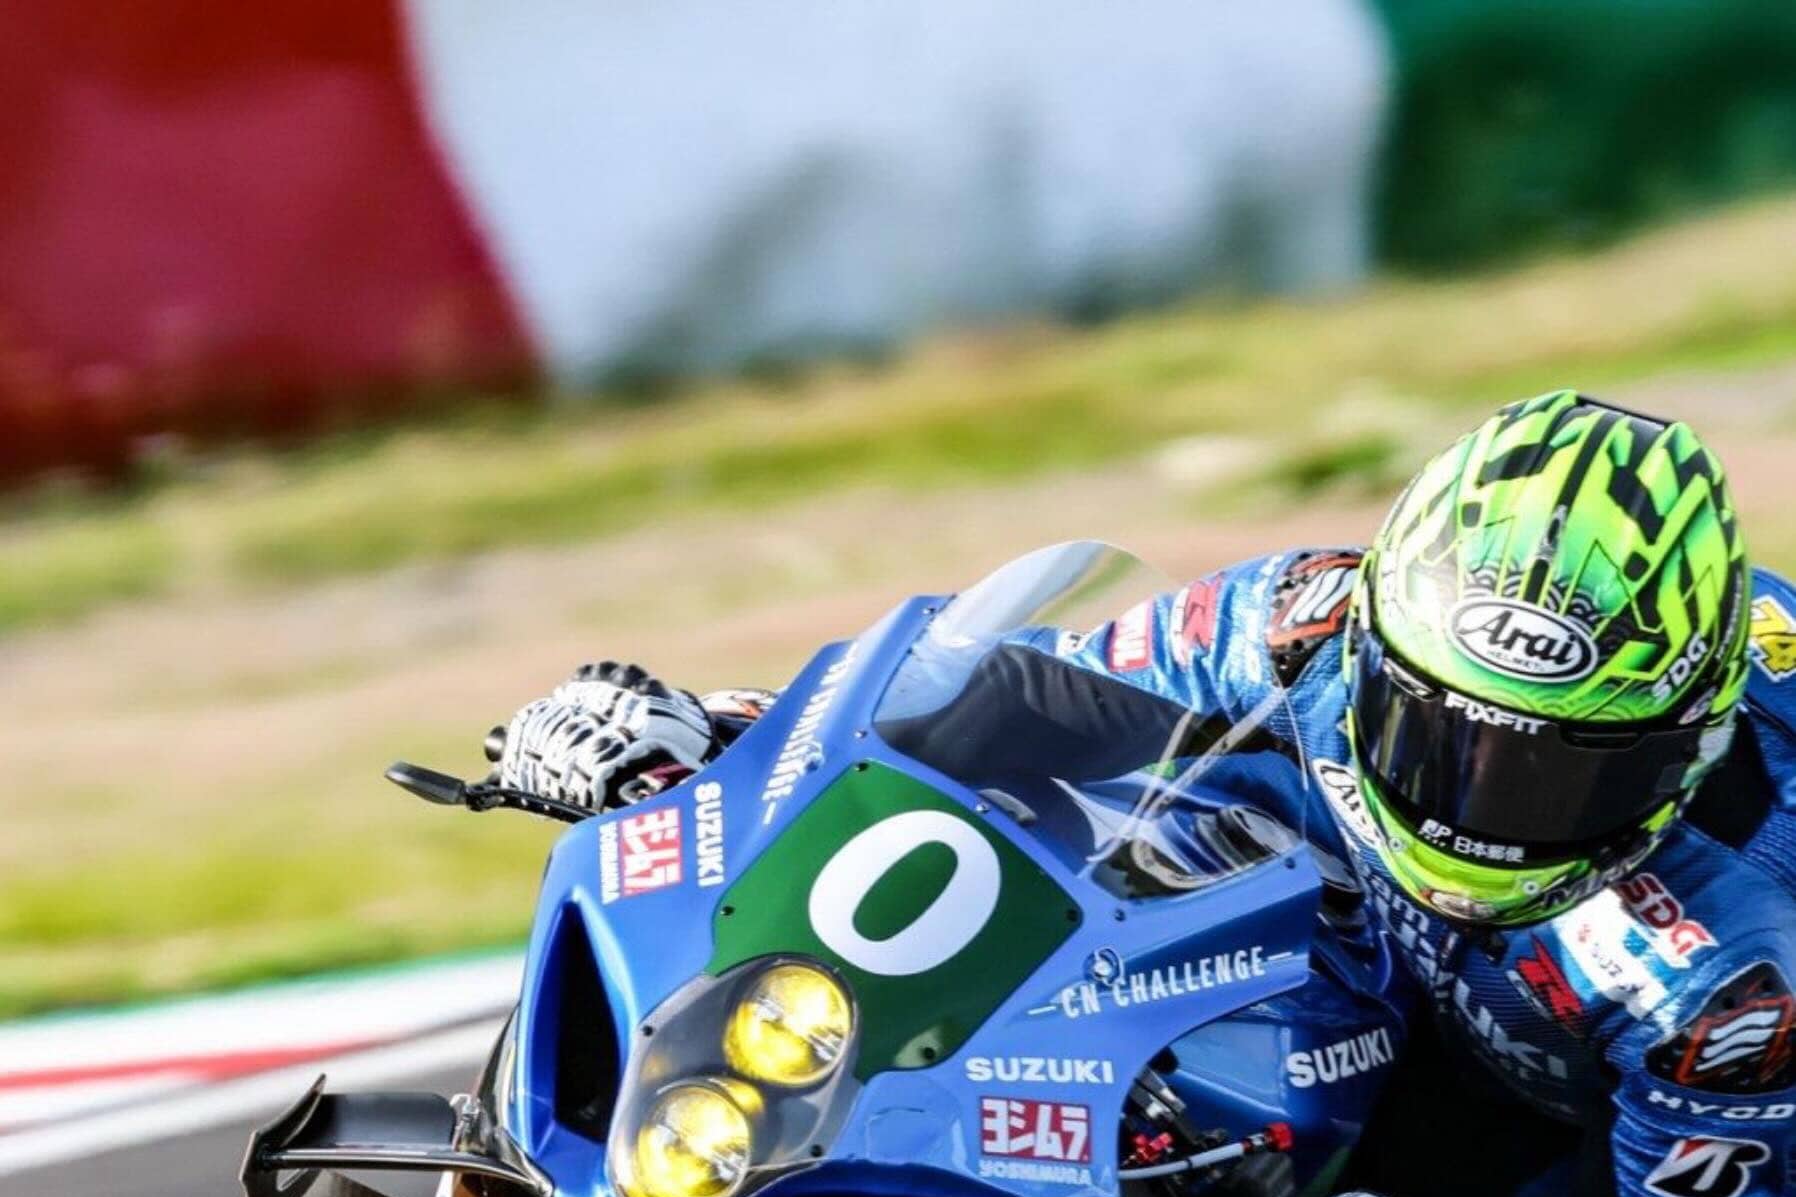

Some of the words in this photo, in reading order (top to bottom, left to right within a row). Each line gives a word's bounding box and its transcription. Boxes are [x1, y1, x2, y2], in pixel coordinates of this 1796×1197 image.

[1455, 609, 1577, 666] Arai
[695, 781, 724, 888] SUZUKI
[808, 810, 1001, 977] 0
[1612, 871, 1716, 957] SDG
[1061, 983, 1101, 1018] CN
[1112, 946, 1267, 1007] CHALLENGE
[965, 1056, 1115, 1084] SUZUKI
[1285, 1026, 1394, 1089] SUZUKI
[982, 1098, 1089, 1161] ヨシムラ
